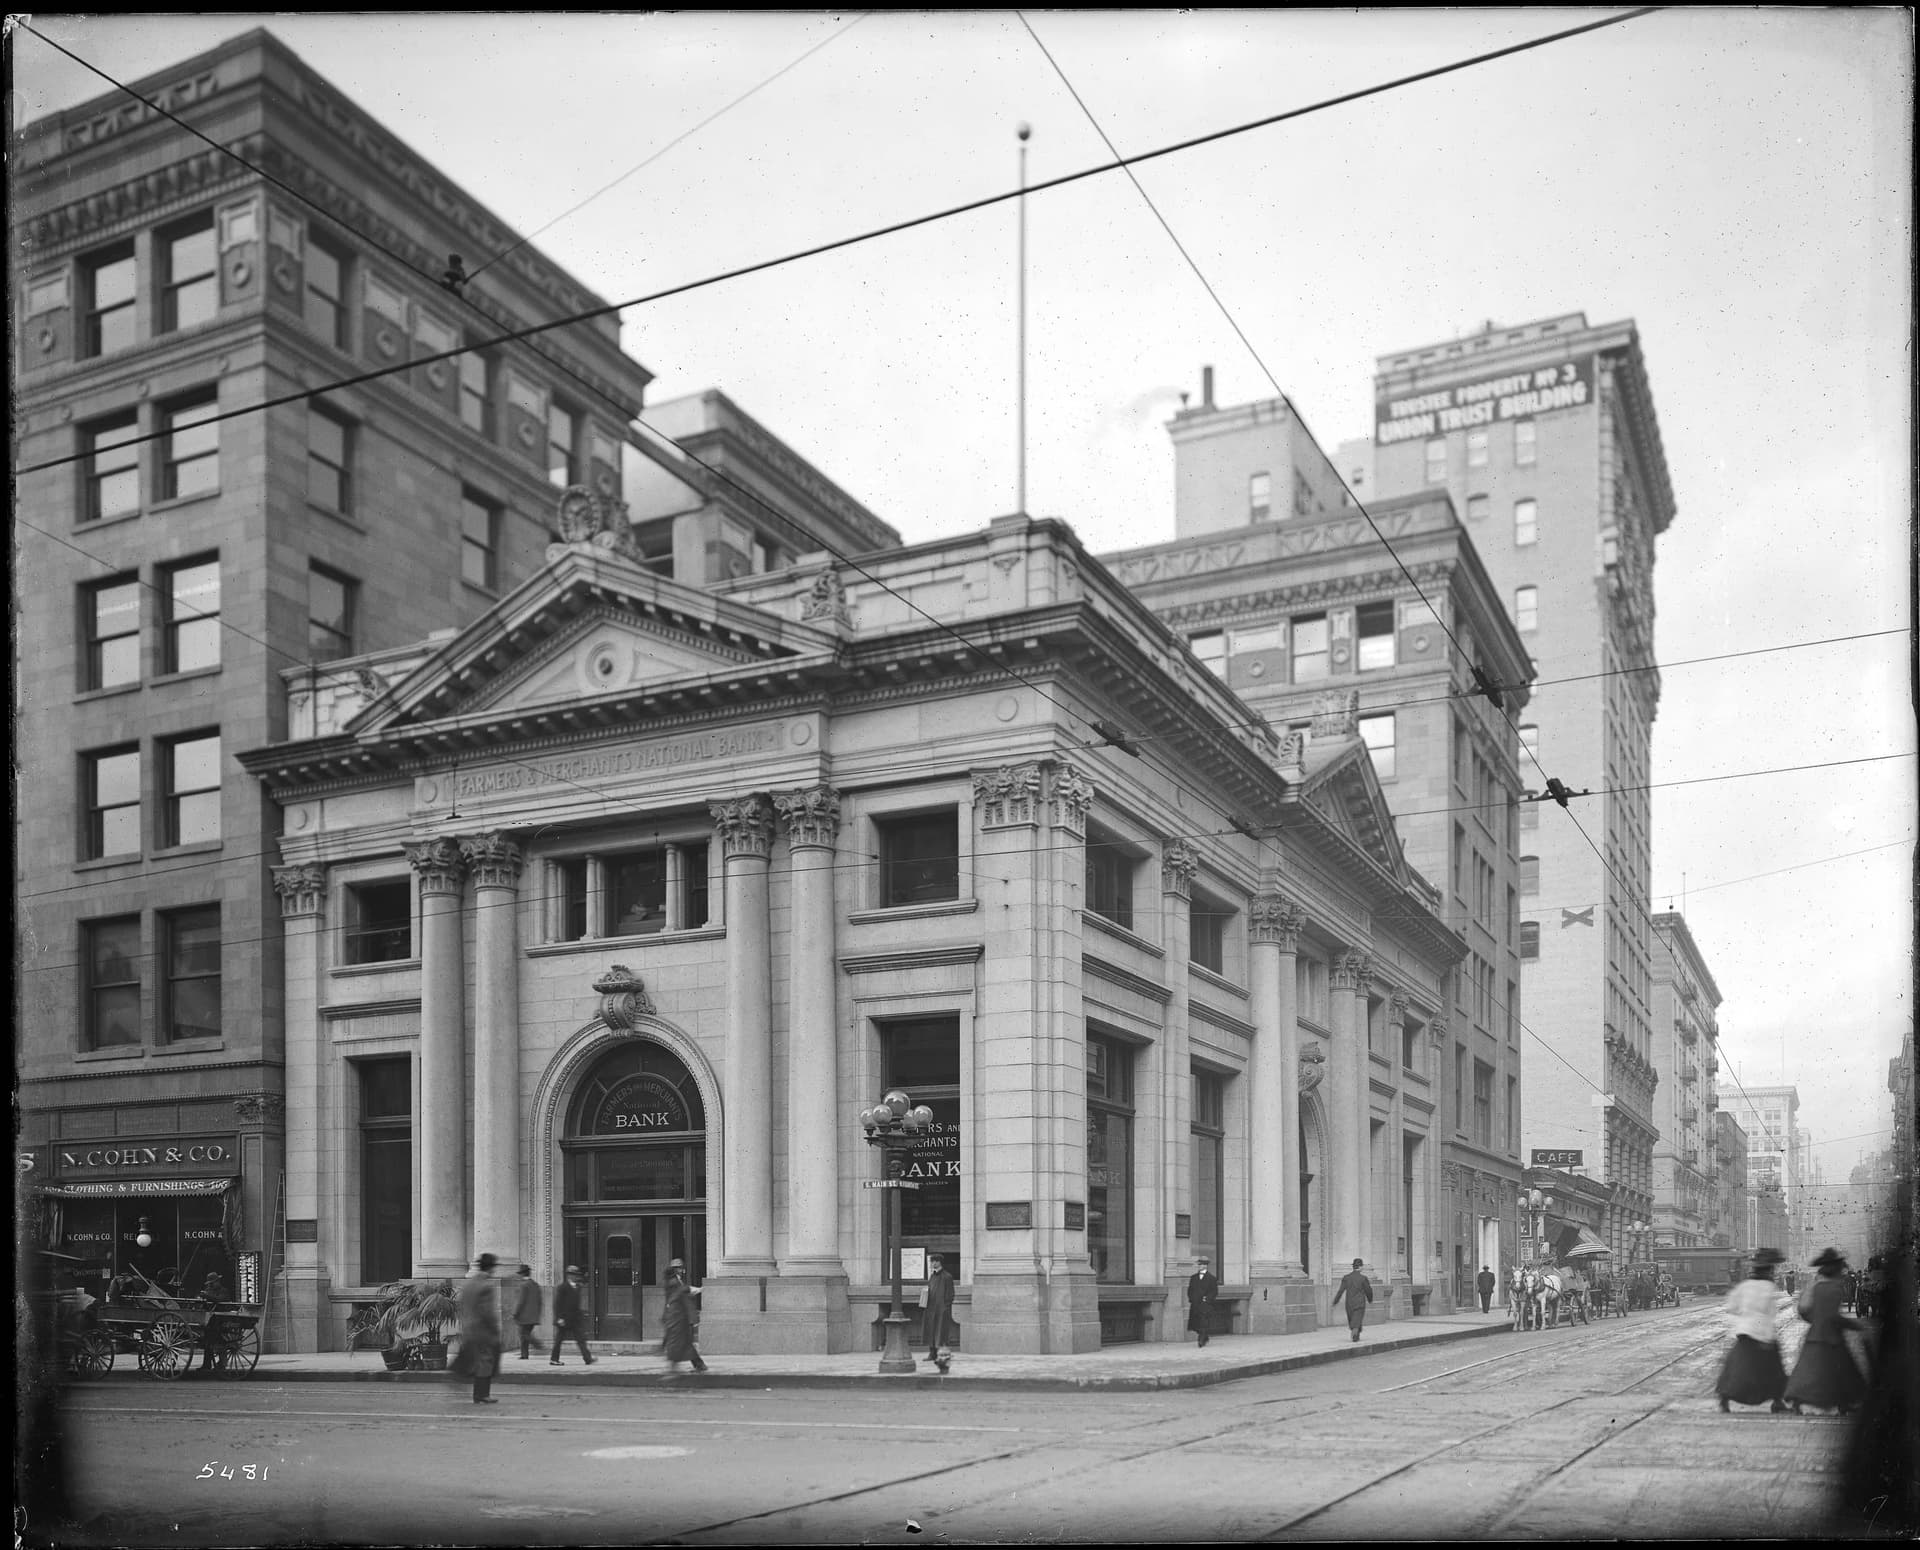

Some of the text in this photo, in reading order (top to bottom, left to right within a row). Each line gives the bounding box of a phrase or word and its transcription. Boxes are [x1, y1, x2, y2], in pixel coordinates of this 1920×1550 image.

[1561, 363, 1577, 383] 3
[1378, 380, 1587, 444] UNION TRUST BUILDING
[459, 729, 763, 796] FARMERS & MERCHANTS NATIONAL BANK
[615, 1112, 670, 1128] BANK
[165, 1147, 184, 1162] &
[189, 1145, 231, 1161] CO.
[1536, 1152, 1577, 1163] CAFE
[64, 1183, 114, 1194] CLOTHING
[118, 1183, 127, 1192] &
[131, 1180, 205, 1192] FURNISHINGS
